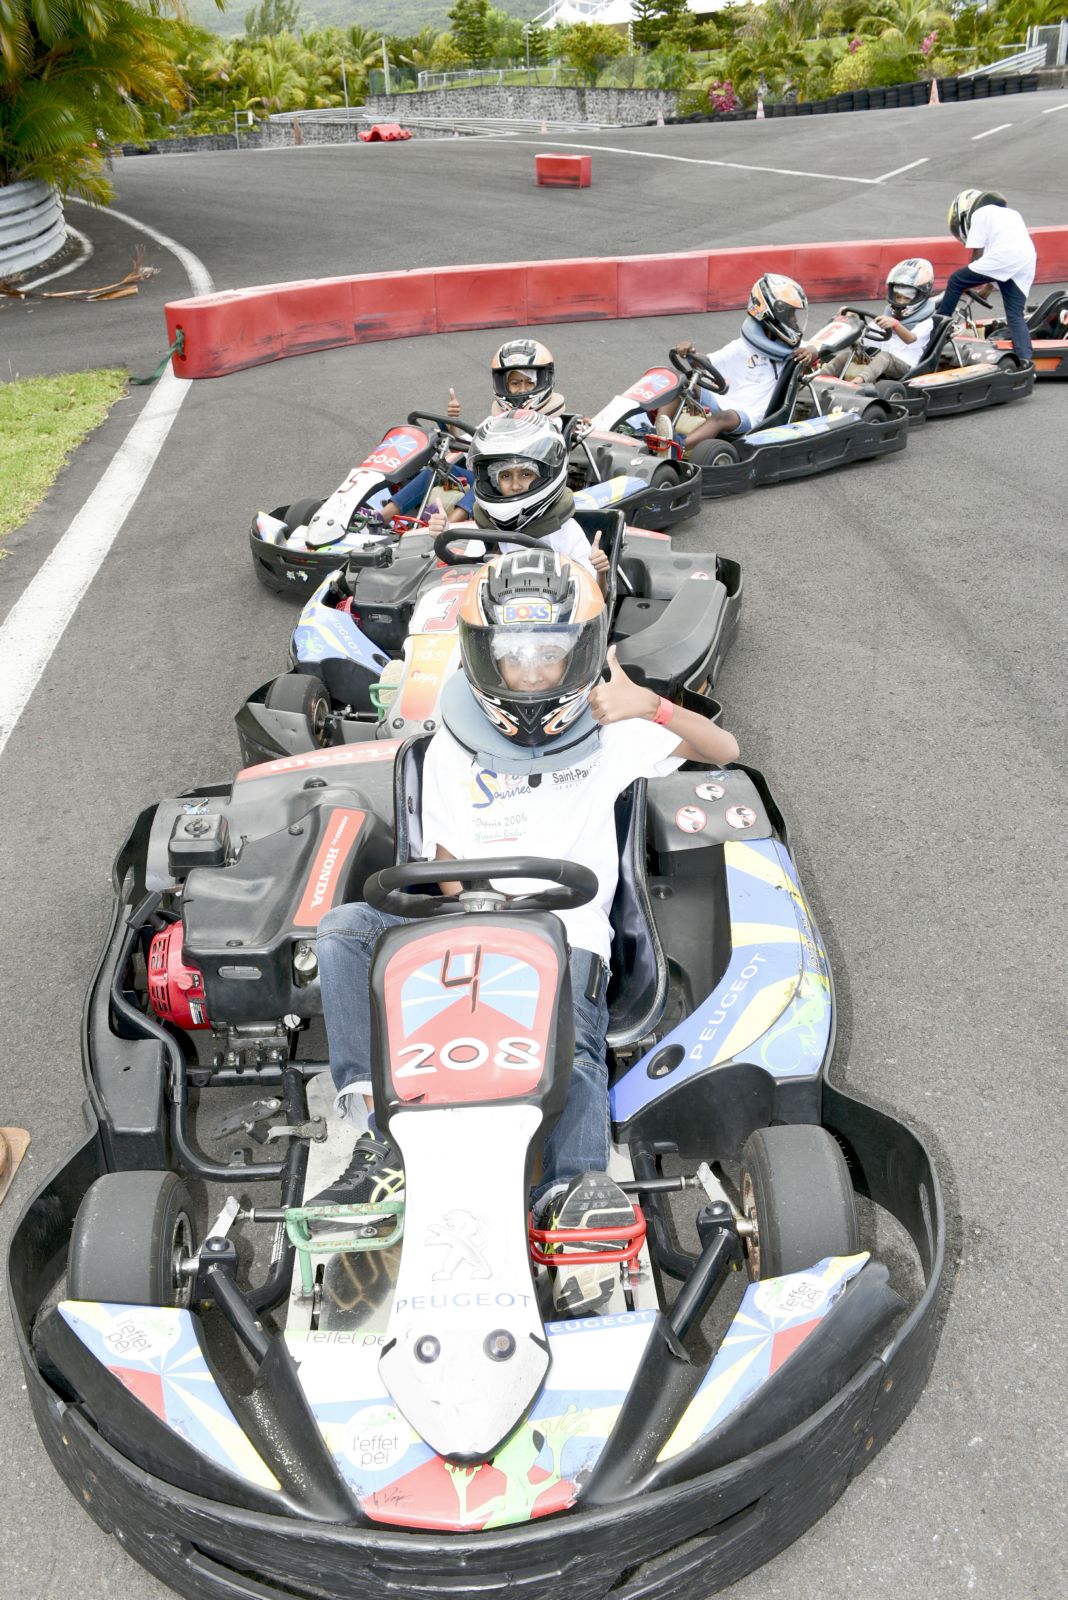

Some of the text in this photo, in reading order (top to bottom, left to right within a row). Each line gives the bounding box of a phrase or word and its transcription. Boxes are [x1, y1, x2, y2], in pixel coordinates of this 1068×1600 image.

[363, 454, 401, 468] 208
[505, 604, 550, 621] BOXS
[325, 612, 364, 656] PEUGEOT
[270, 746, 397, 772] rt.com
[504, 812, 528, 827] 2006
[311, 847, 340, 907] HONDA
[440, 943, 484, 1014] 4
[689, 952, 768, 1061] PEUGEOT
[394, 1036, 541, 1079] 208
[395, 1292, 530, 1313] PEUGEOT
[548, 1311, 650, 1332] EUGEOT
[362, 1334, 385, 1347] pe
[353, 1434, 399, 1452] l'effet
